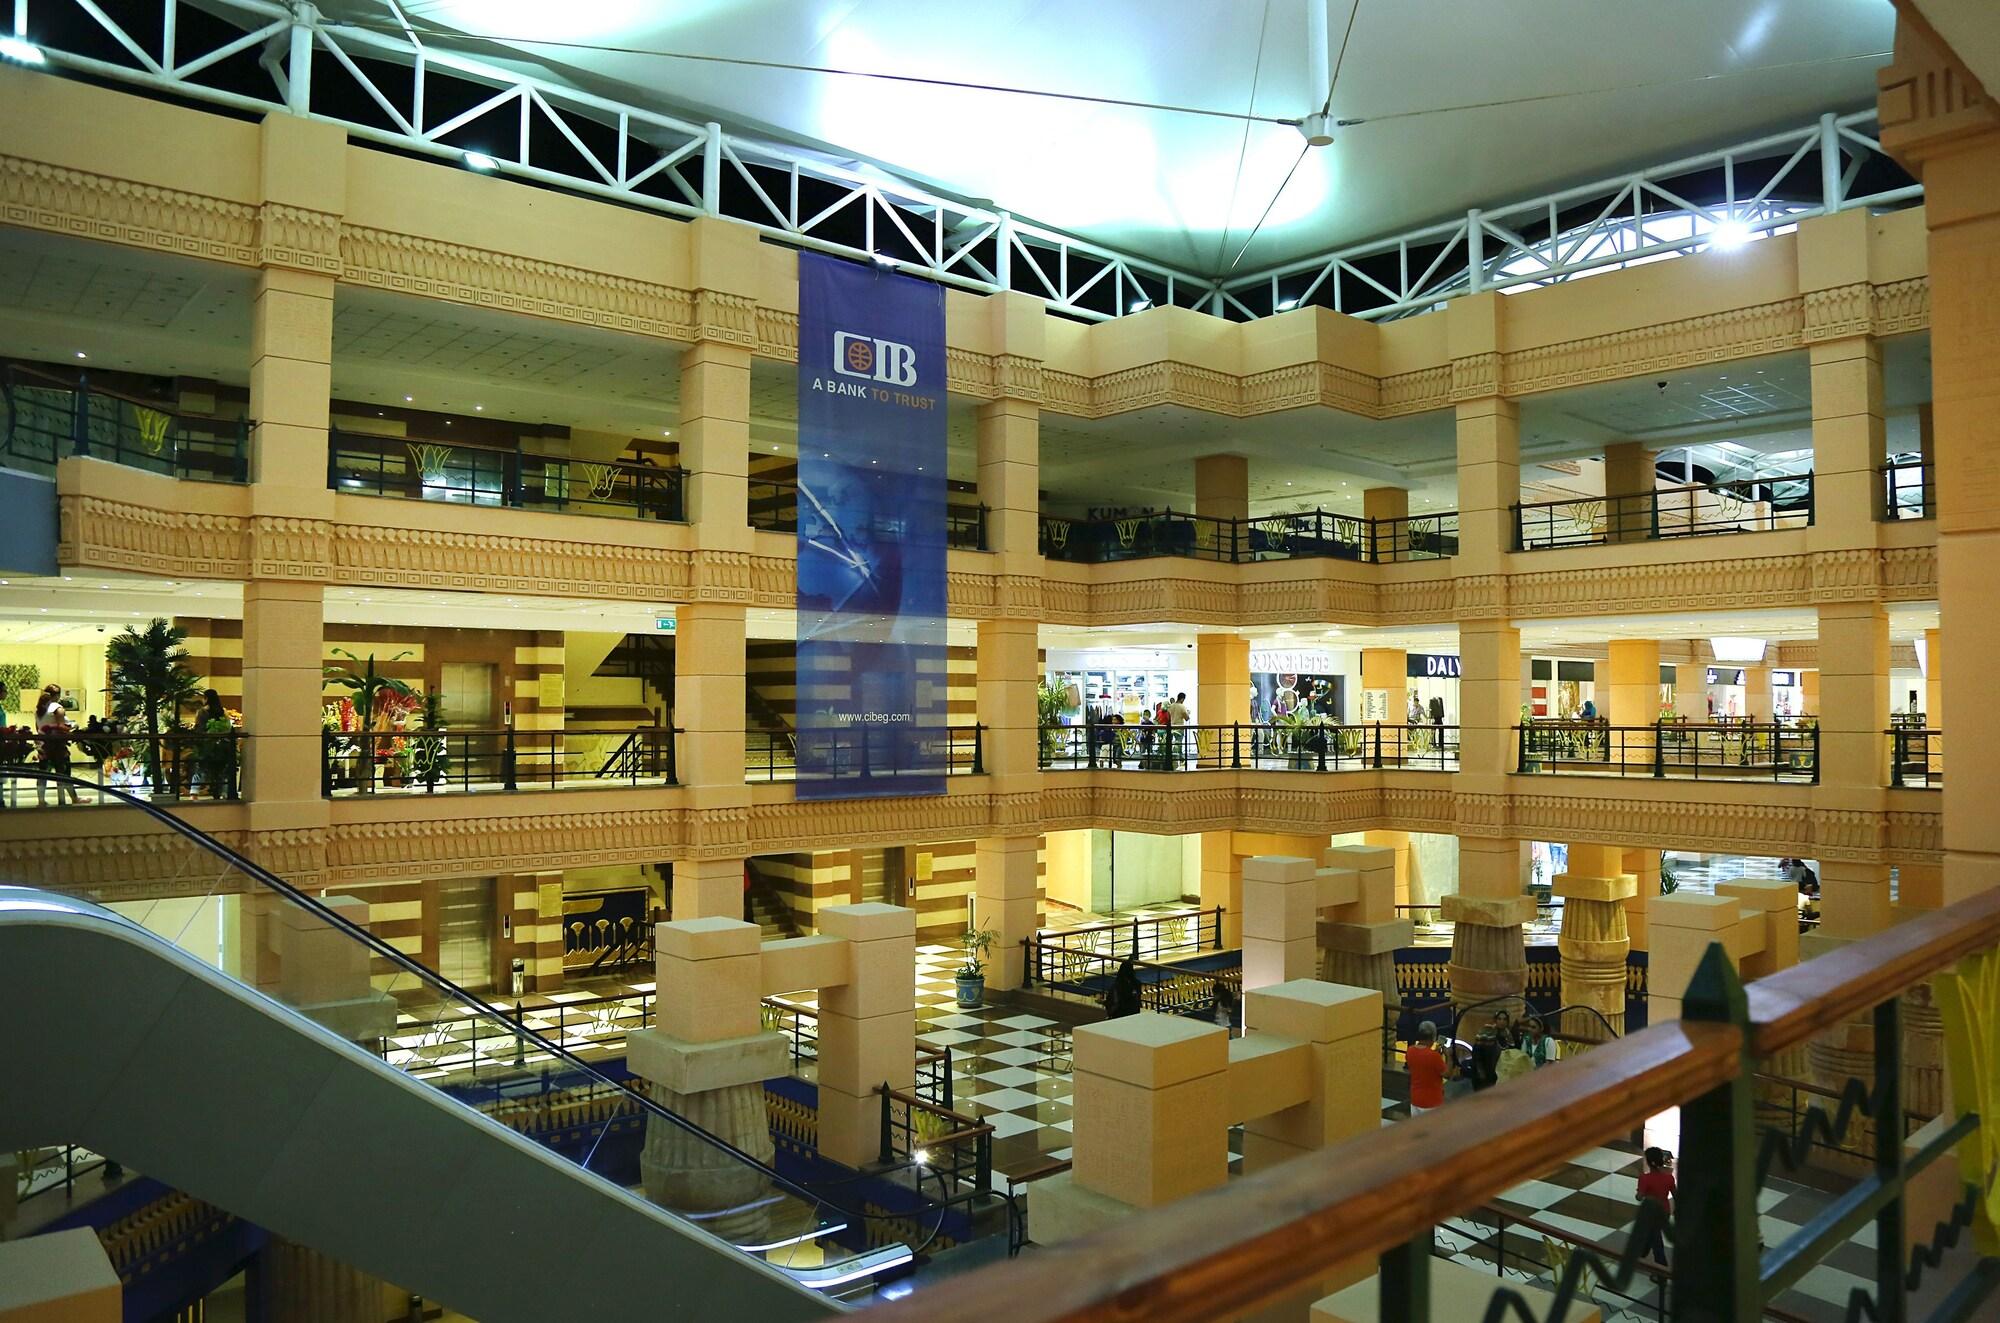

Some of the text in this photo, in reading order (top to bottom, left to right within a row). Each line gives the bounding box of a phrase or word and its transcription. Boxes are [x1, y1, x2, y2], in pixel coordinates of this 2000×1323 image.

[812, 378, 935, 411] A BANK TO TRUST
[838, 712, 910, 724] www.cibeg.com
